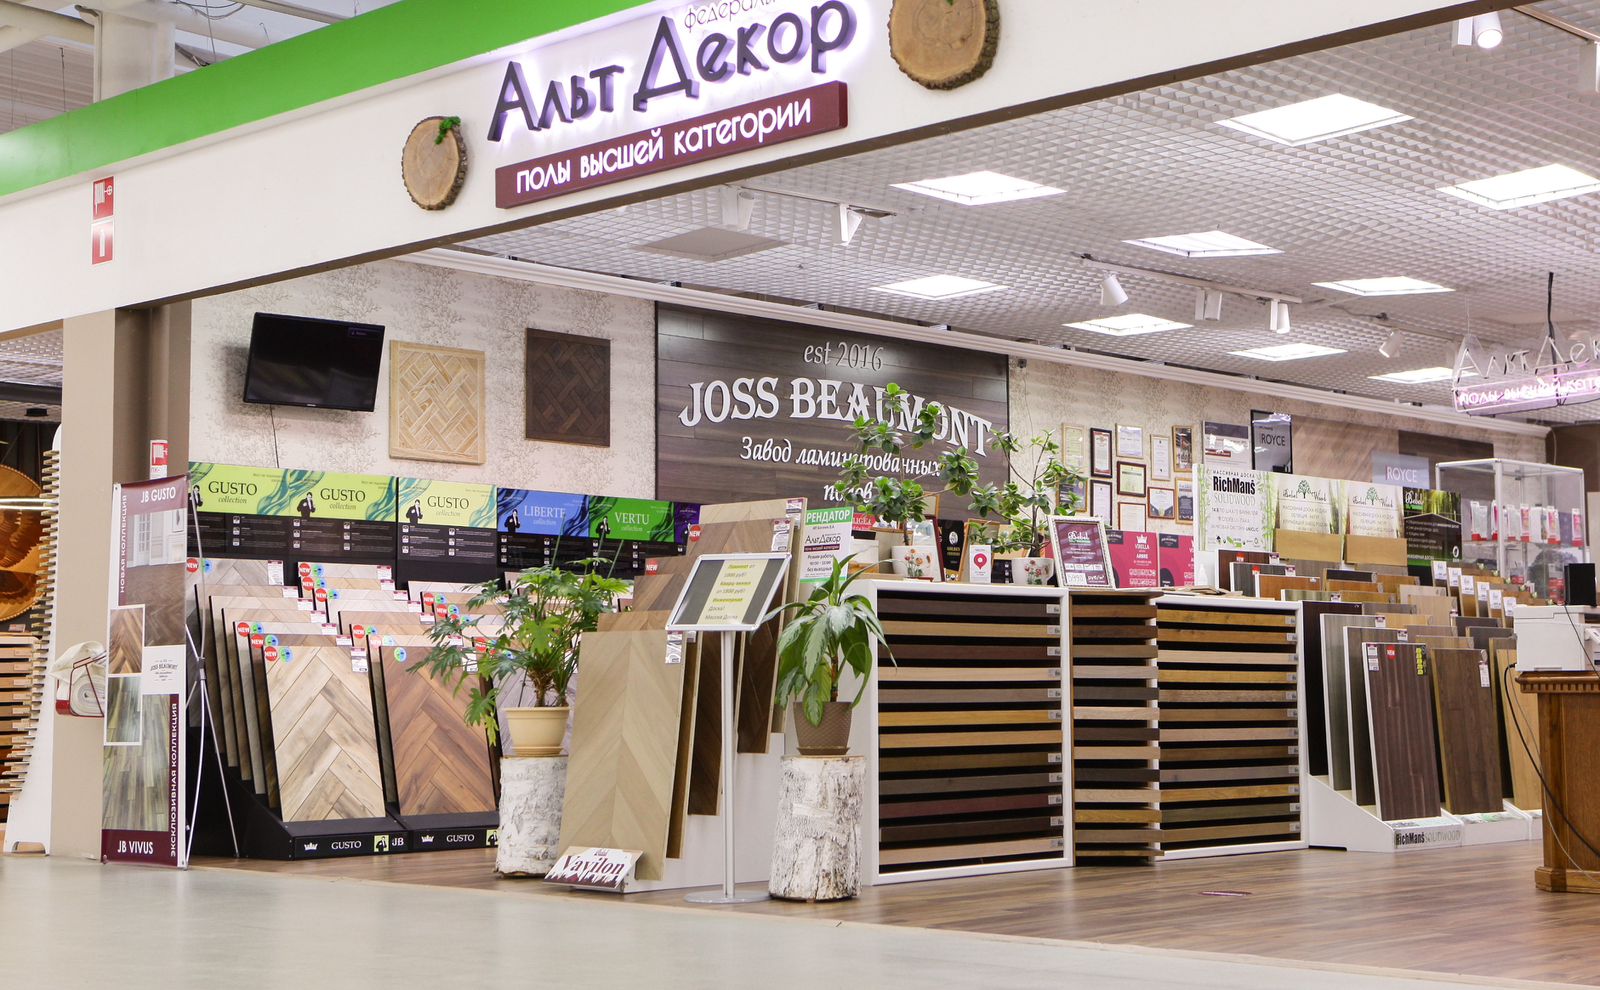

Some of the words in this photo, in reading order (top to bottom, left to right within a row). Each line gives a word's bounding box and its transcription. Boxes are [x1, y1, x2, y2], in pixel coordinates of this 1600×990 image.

[487, 60, 625, 142] Альт
[632, 0, 857, 112] Декор
[516, 160, 571, 194] полы
[580, 129, 664, 180] высшей
[674, 98, 812, 157] категории
[803, 341, 831, 365] est
[836, 342, 883, 372] 2016
[678, 376, 779, 428] JOSS
[789, 377, 993, 458] BEAUMONT
[1261, 433, 1286, 447] ROYCE
[739, 436, 792, 463] Завод
[1386, 465, 1418, 483] ROYCE
[141, 491, 149, 503] JB
[151, 486, 176, 502] GUSTO
[208, 481, 258, 496] GUSTO
[320, 488, 366, 502] GUSTO
[217, 495, 248, 504] collection
[329, 502, 357, 510] collection
[427, 495, 470, 509] GUSTO
[614, 511, 649, 525] VERTU
[331, 840, 362, 850] GUSTO
[392, 837, 404, 846] JB
[446, 834, 475, 843] GUSTO
[117, 840, 127, 854] JB
[129, 841, 154, 855] VIVUS
[563, 855, 625, 880] Vavilon
